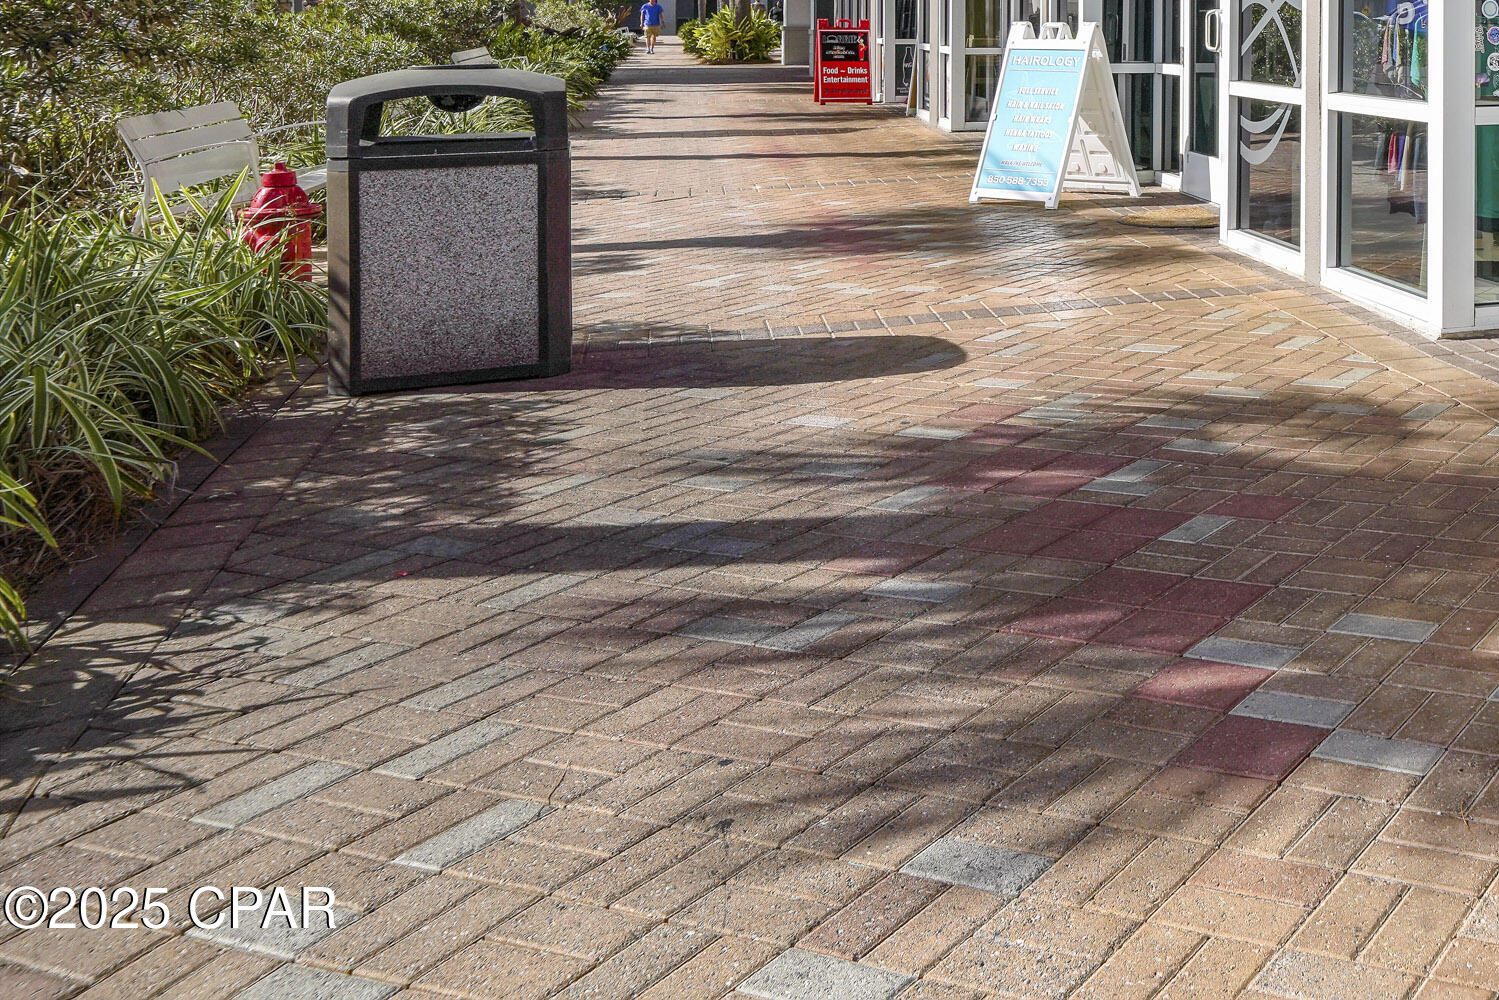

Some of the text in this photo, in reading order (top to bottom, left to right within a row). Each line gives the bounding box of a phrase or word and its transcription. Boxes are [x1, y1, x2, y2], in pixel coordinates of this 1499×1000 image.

[1012, 55, 1081, 67] HAIROLOGY
[823, 66, 839, 74] Food
[847, 66, 868, 74] Drinks
[823, 75, 868, 83] Entertainment
